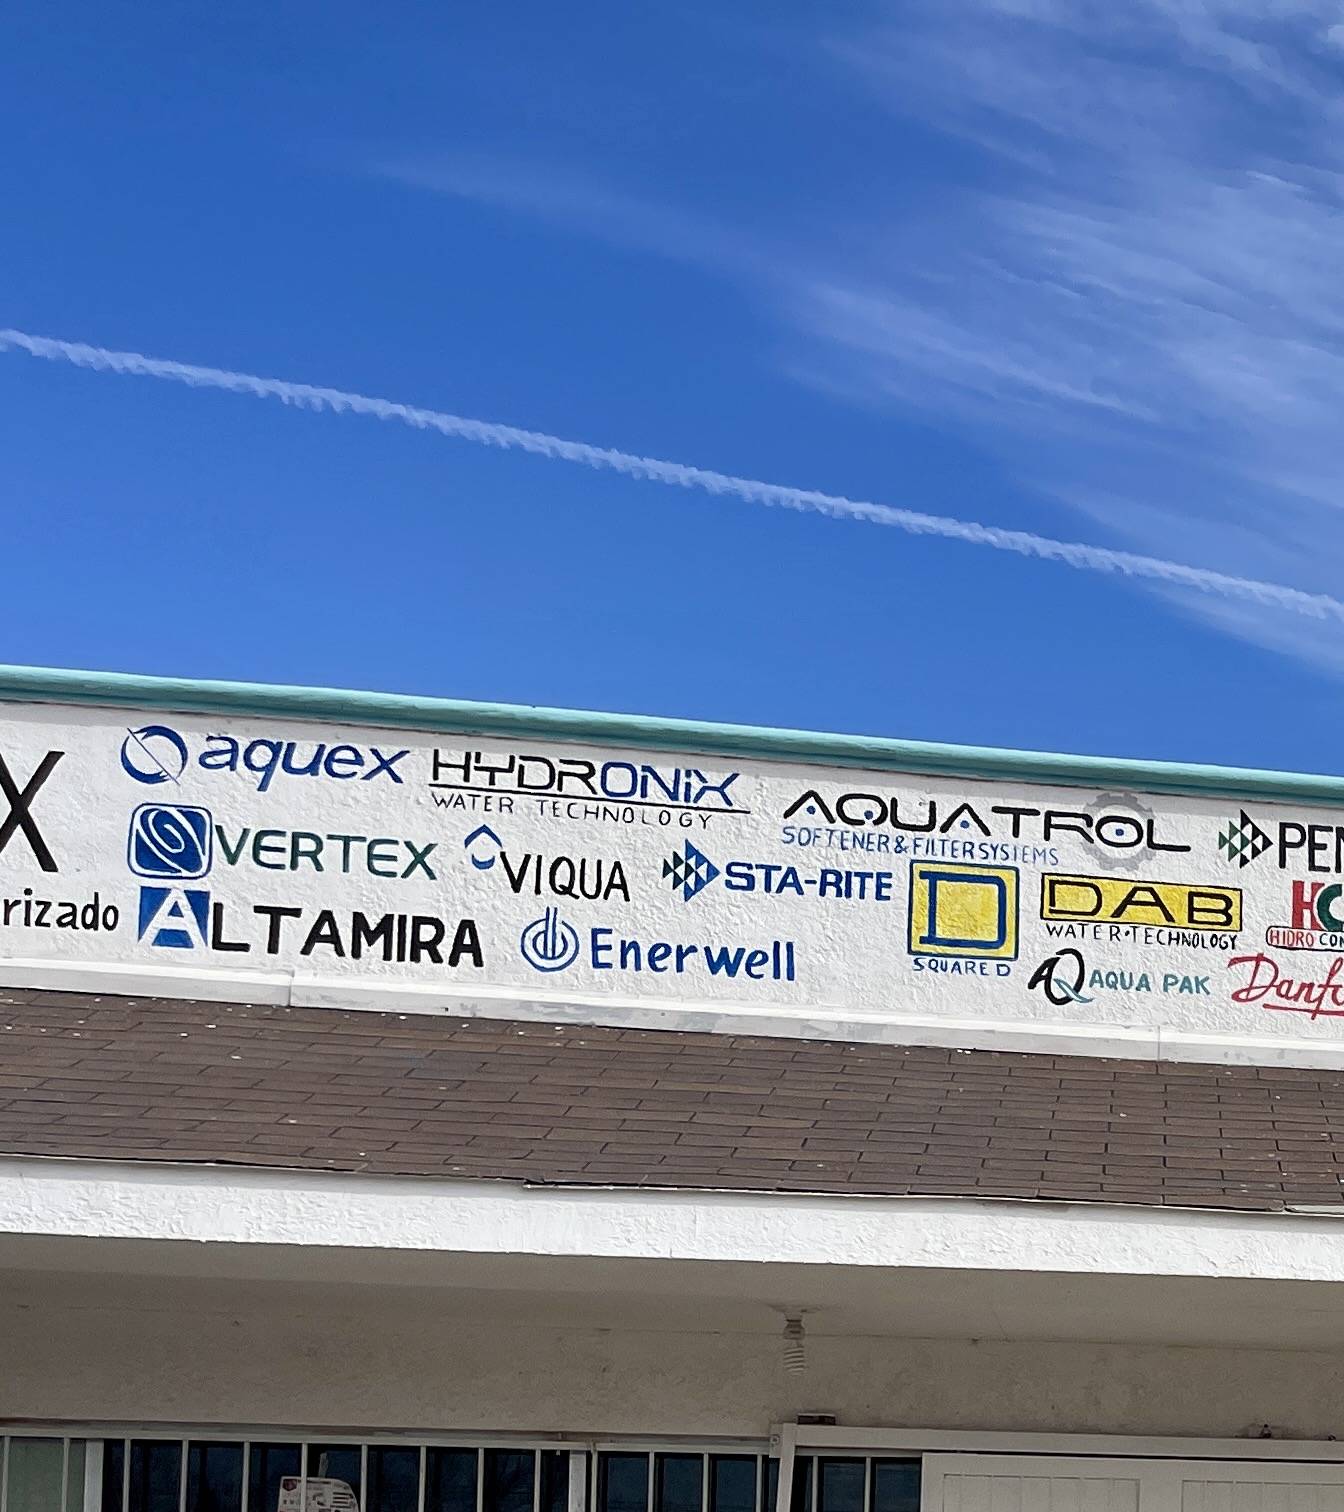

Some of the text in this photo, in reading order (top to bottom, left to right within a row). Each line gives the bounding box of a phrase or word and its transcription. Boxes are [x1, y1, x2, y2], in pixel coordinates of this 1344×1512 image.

[199, 734, 411, 792] aquex
[430, 792, 713, 830] WATER TECHNOLOGY
[783, 789, 1192, 853] AQUATROL
[213, 824, 440, 881] VERTEX
[782, 826, 889, 854] SOFTENER
[501, 850, 631, 902] VIQUA
[725, 862, 893, 902] STA-RITE
[3, 888, 119, 932] rizado
[1048, 881, 1233, 927] DAB
[138, 886, 485, 968] ALTAMIRA
[1269, 929, 1315, 948] HIDRO
[591, 928, 796, 982] Enerwell
[912, 956, 1011, 978] SQUARE D
[1088, 968, 1211, 995] AQUA PAK
